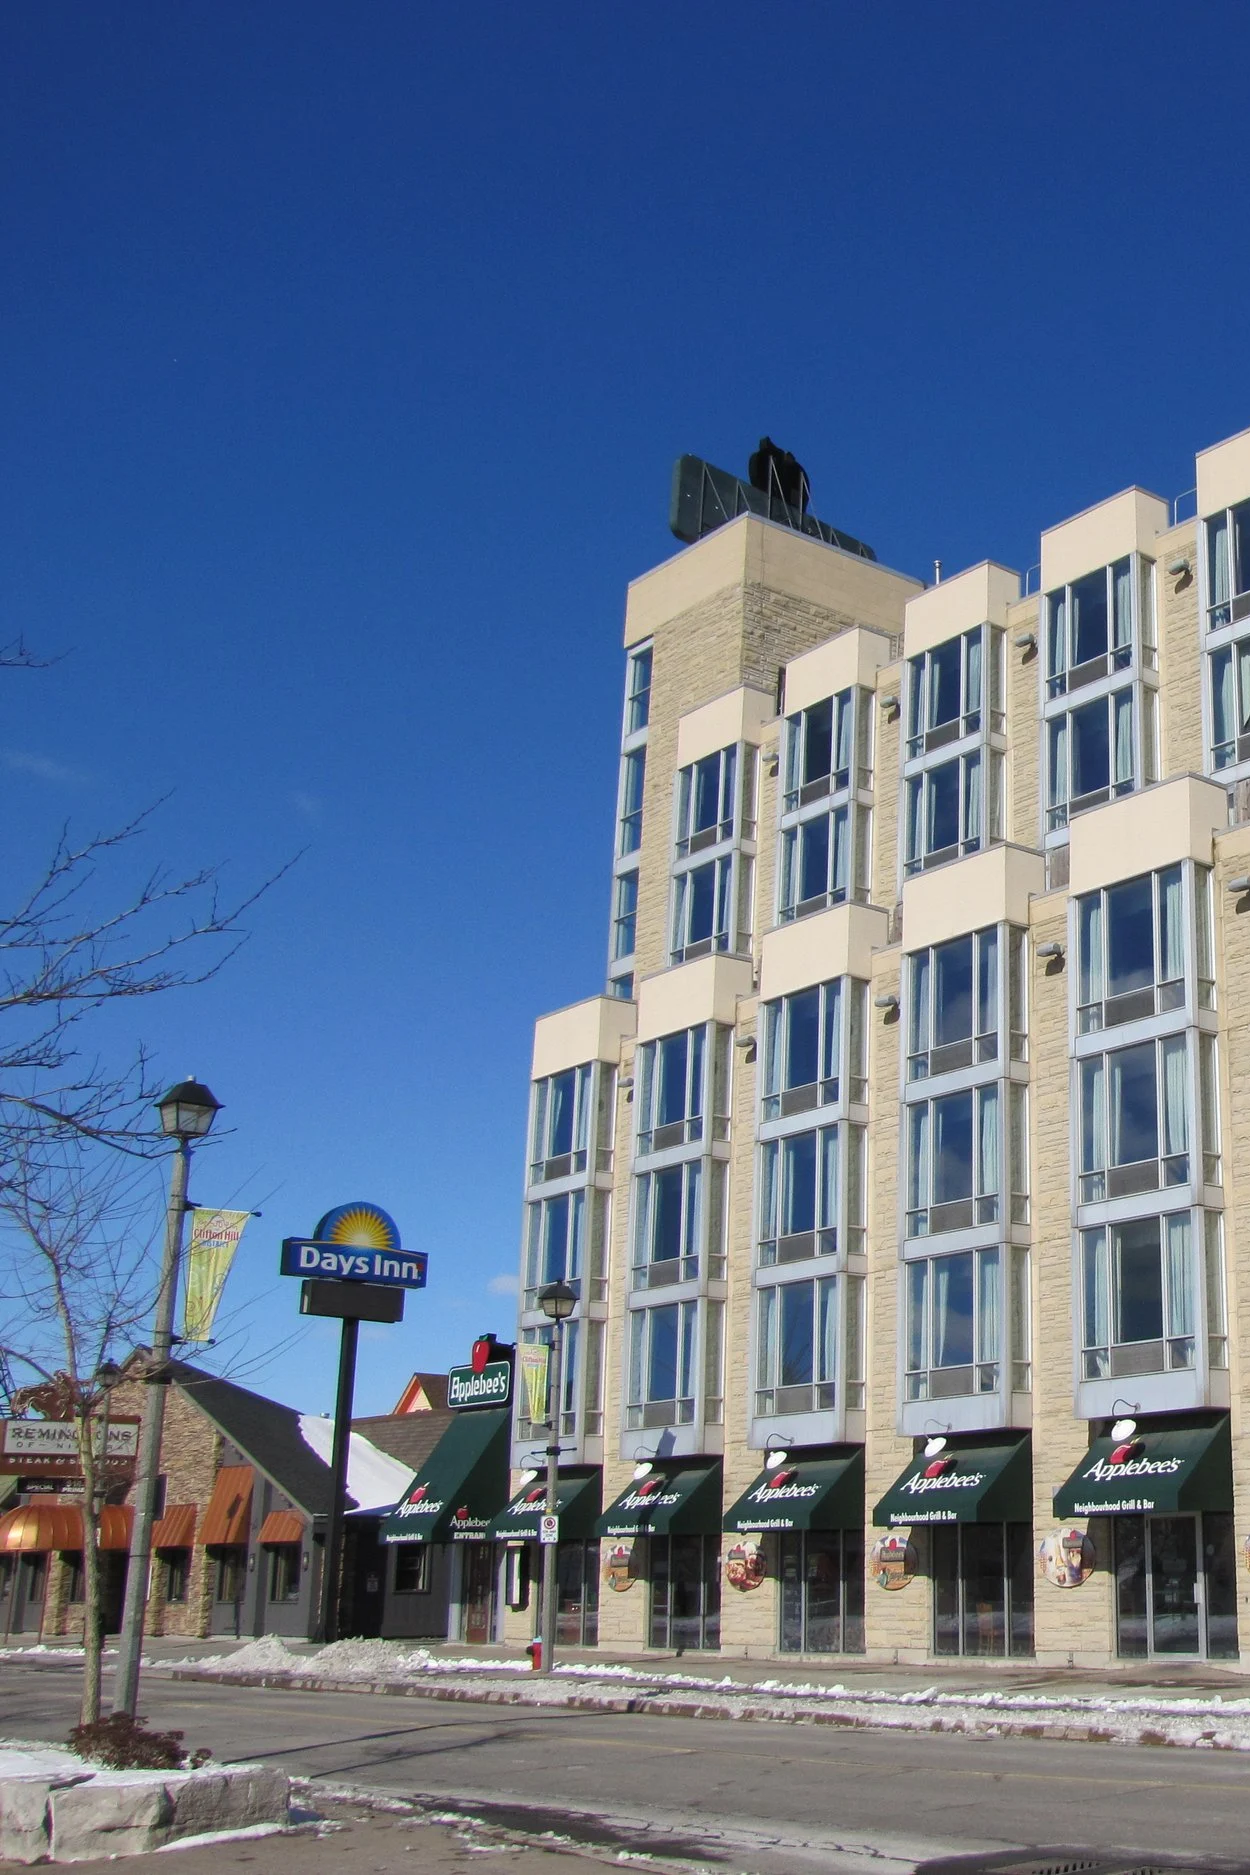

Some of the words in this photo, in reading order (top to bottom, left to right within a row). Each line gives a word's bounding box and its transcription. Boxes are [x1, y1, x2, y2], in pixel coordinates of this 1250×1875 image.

[194, 1229, 223, 1240] Clifton
[225, 1231, 239, 1241] Hill
[300, 1246, 369, 1275] Days
[374, 1254, 419, 1280] Inn
[451, 1372, 507, 1402] Applebee's
[12, 1427, 132, 1441] REMINONS
[1083, 1457, 1182, 1481] Applebee's
[900, 1471, 984, 1493] Applebee's
[618, 1490, 682, 1510] Applebee's
[748, 1482, 820, 1503] Applebee's
[395, 1498, 443, 1518] Applebee's
[890, 1511, 929, 1524] Neighbourhood
[930, 1511, 941, 1520] Grill
[942, 1511, 946, 1520] &
[947, 1510, 957, 1520] Bar
[1074, 1500, 1120, 1515] Neighbourhood
[1121, 1499, 1135, 1510] Grill
[1137, 1500, 1141, 1509] &
[1143, 1499, 1154, 1509] Bar
[450, 1515, 491, 1529] Applebe
[454, 1532, 485, 1540] ENTRAN
